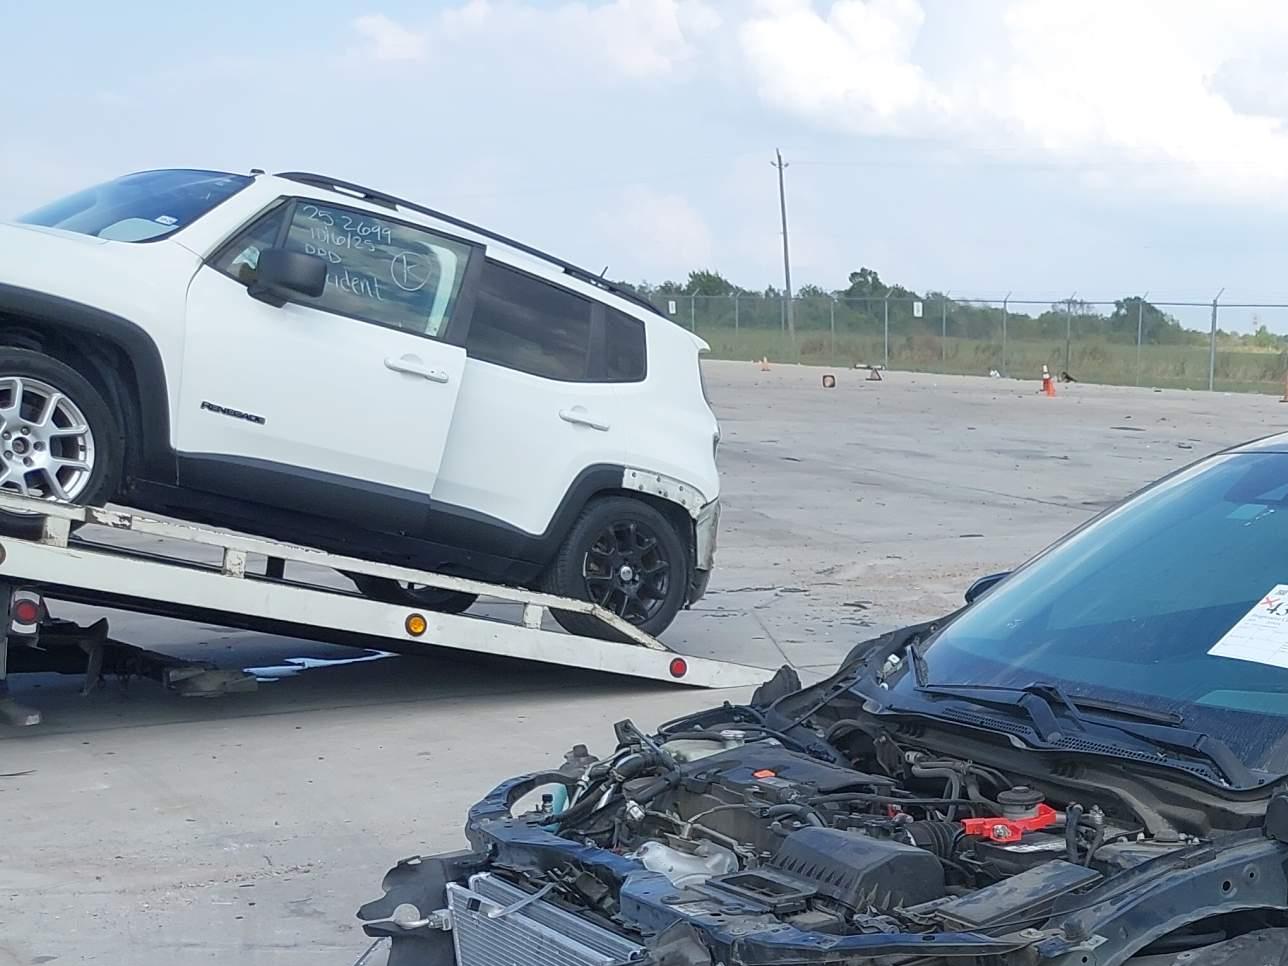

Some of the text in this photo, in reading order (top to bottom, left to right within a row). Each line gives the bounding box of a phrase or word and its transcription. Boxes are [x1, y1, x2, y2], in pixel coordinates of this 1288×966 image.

[303, 205, 392, 244] 25 2699
[200, 400, 266, 425] RENEGADE
